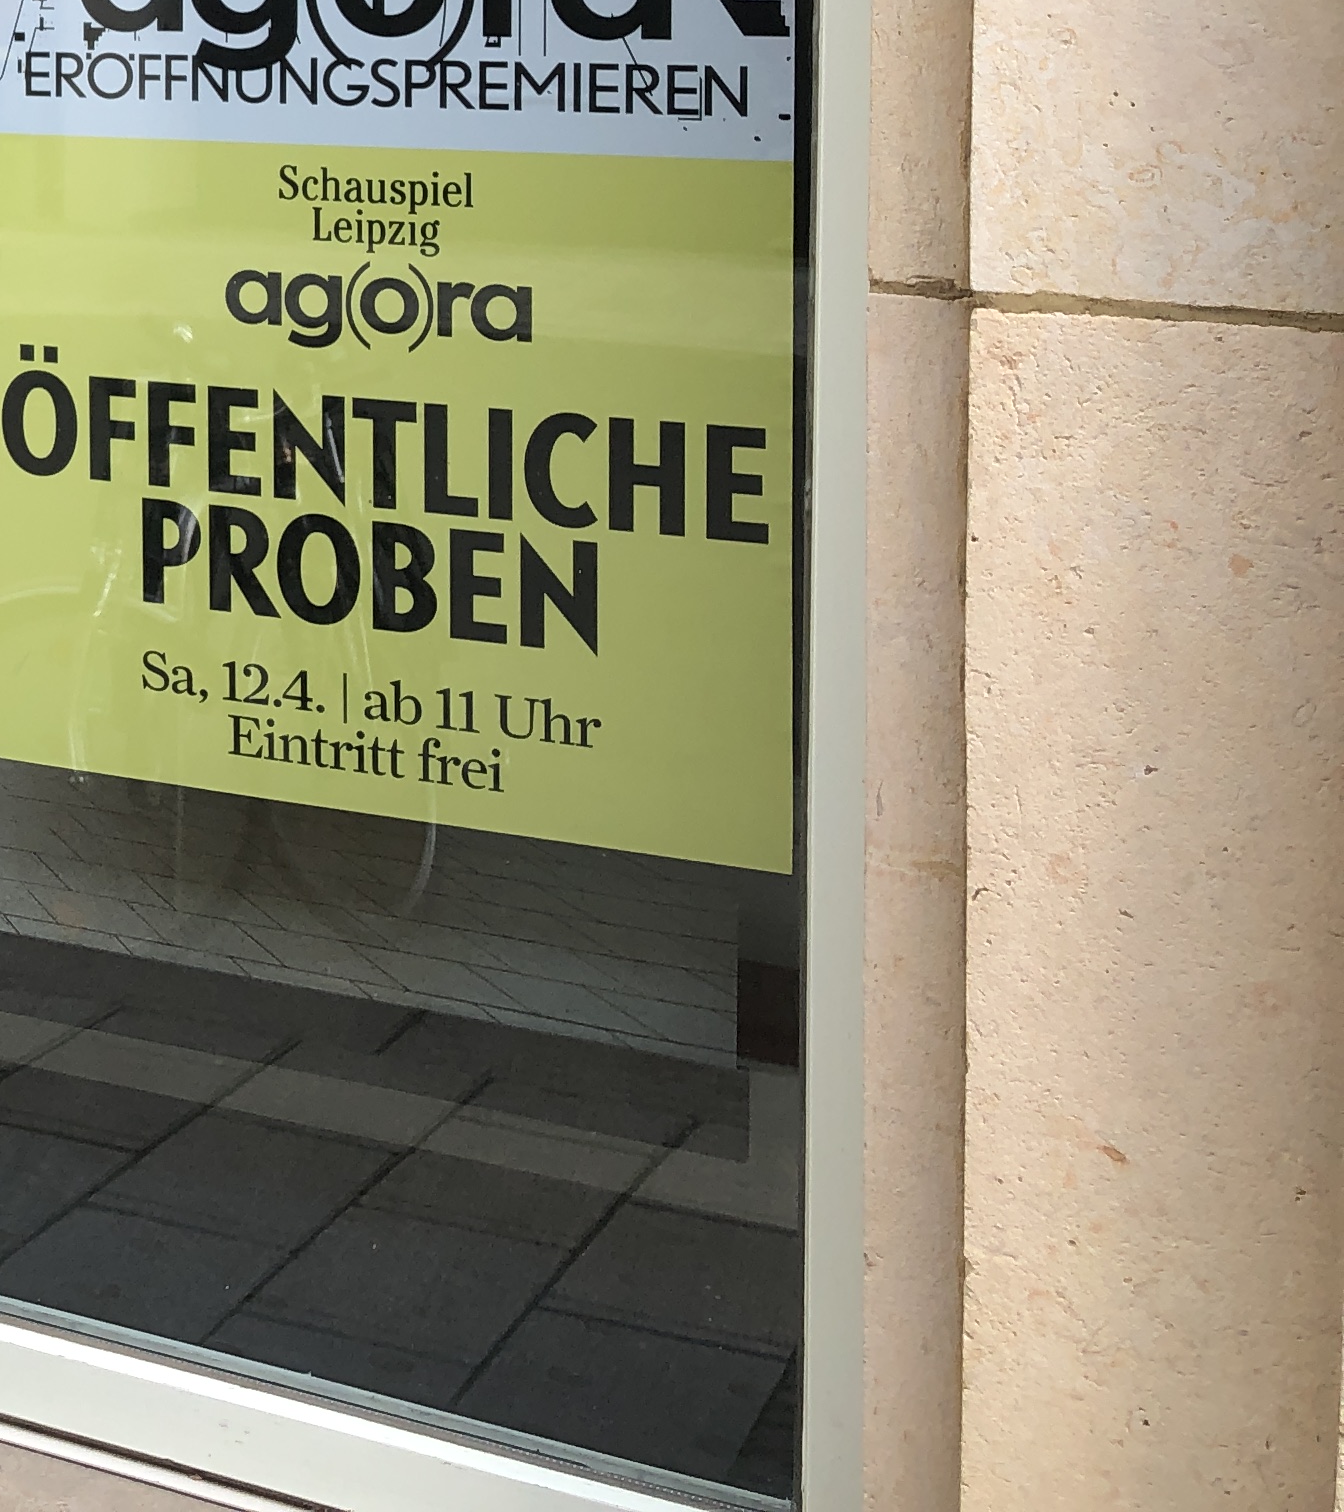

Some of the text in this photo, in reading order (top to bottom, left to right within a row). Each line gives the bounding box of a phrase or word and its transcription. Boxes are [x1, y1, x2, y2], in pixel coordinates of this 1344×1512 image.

[24, 49, 749, 118] ERÖFFNUNGSPREMIEREN
[278, 164, 474, 215] Schauspiel
[312, 206, 441, 256] Leipzig
[225, 261, 532, 353] ag(o)ra
[1, 344, 770, 544] ÖFFENTLICHE
[142, 497, 599, 657] PROBEN
[141, 650, 210, 704] Sa,
[222, 660, 326, 715] 12.4.
[363, 681, 422, 726] ab
[435, 688, 478, 735] 11
[498, 695, 603, 749] Uhr
[228, 714, 506, 794] Eintritt frei
